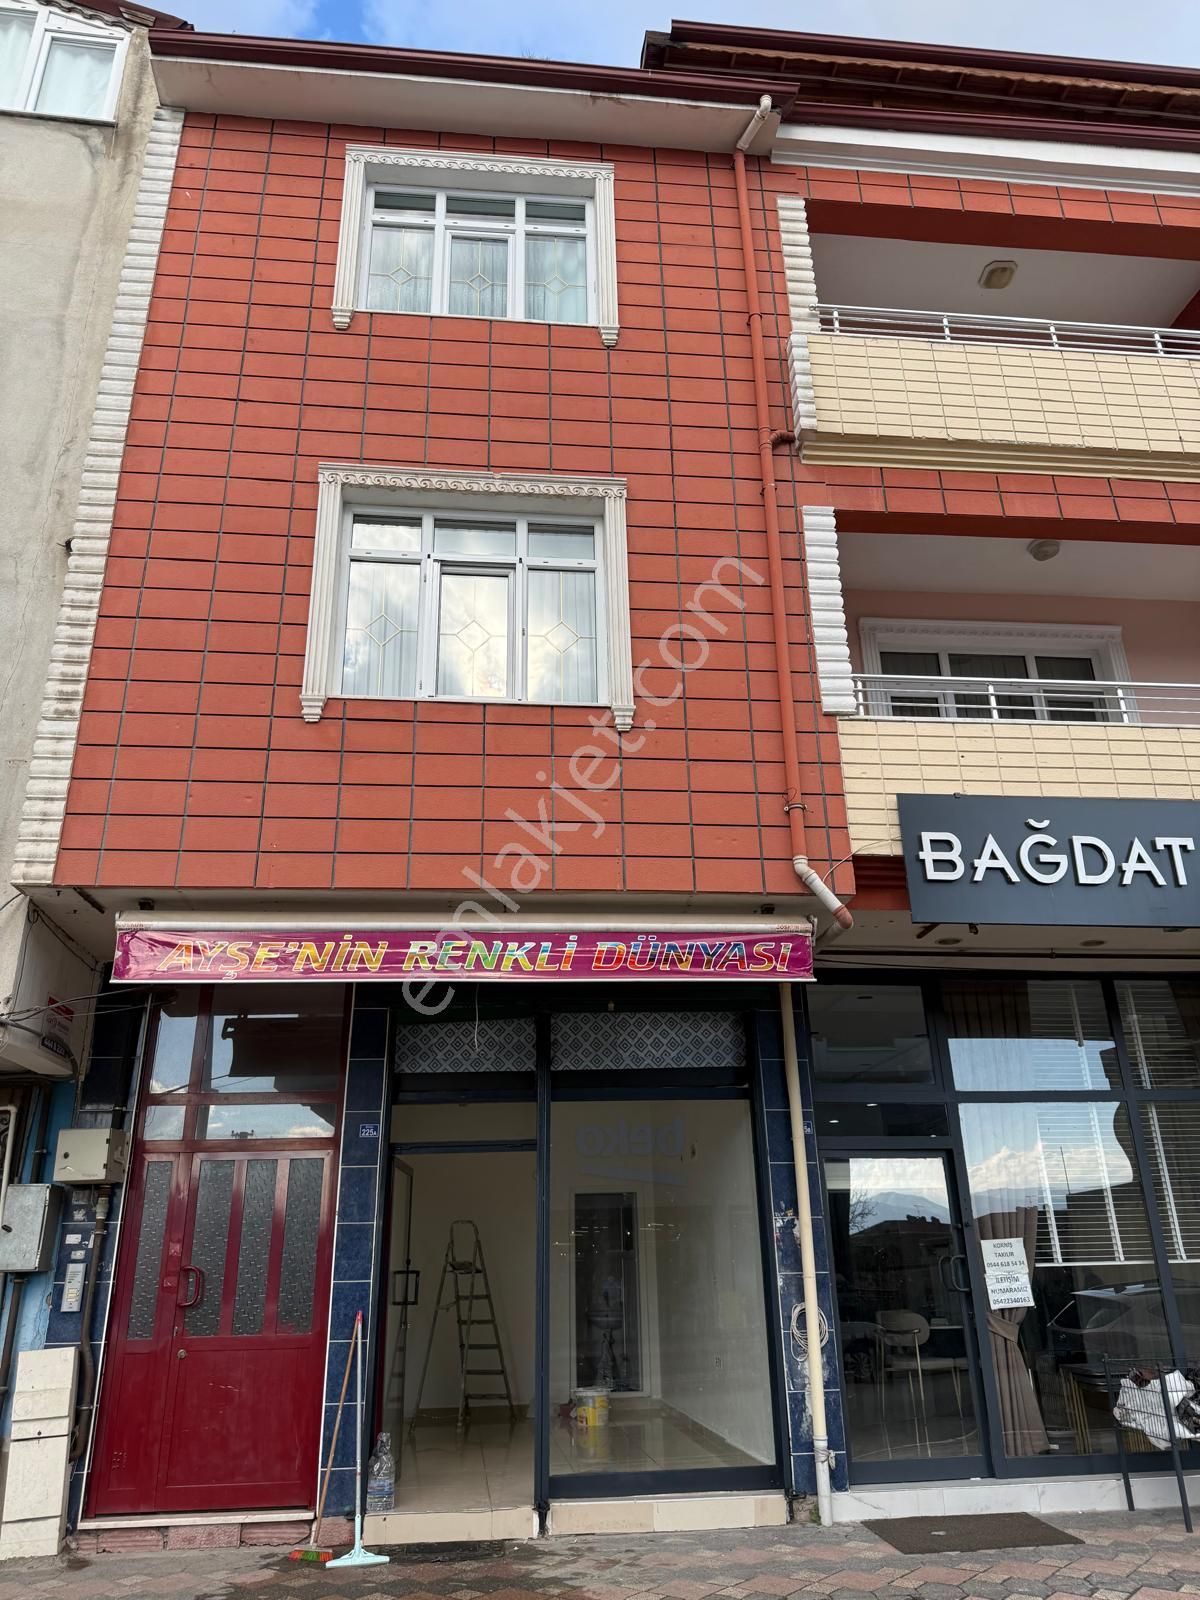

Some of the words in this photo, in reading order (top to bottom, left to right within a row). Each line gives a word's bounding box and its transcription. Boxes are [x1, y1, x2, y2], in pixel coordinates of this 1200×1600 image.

[918, 818, 1195, 886] BAĞDAT
[155, 935, 389, 980] AYŞE'NİN
[402, 936, 579, 971] RENKLİ
[591, 936, 793, 972] DÜNYASI
